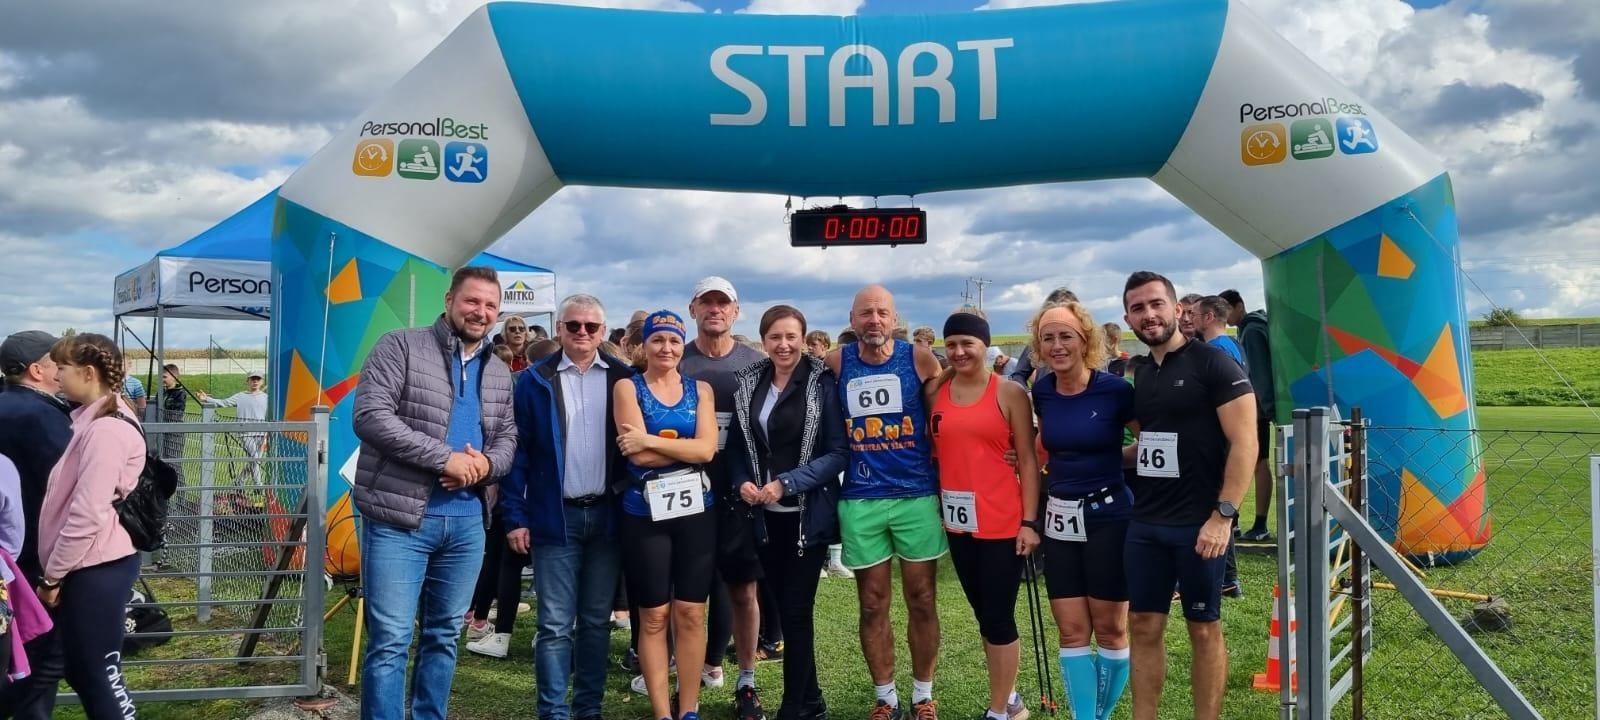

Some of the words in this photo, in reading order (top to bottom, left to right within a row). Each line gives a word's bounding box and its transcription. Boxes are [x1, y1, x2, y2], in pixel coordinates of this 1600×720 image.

[710, 38, 1014, 127] START
[1240, 97, 1367, 123] PersonalBest
[360, 117, 488, 140] PersonalBest
[825, 216, 919, 240] 0:00:00
[503, 291, 535, 301] MITKO
[858, 388, 890, 409] 60
[1139, 447, 1166, 469] 46
[662, 489, 693, 511] 75
[947, 504, 968, 525] 76
[1046, 510, 1079, 534] 751
